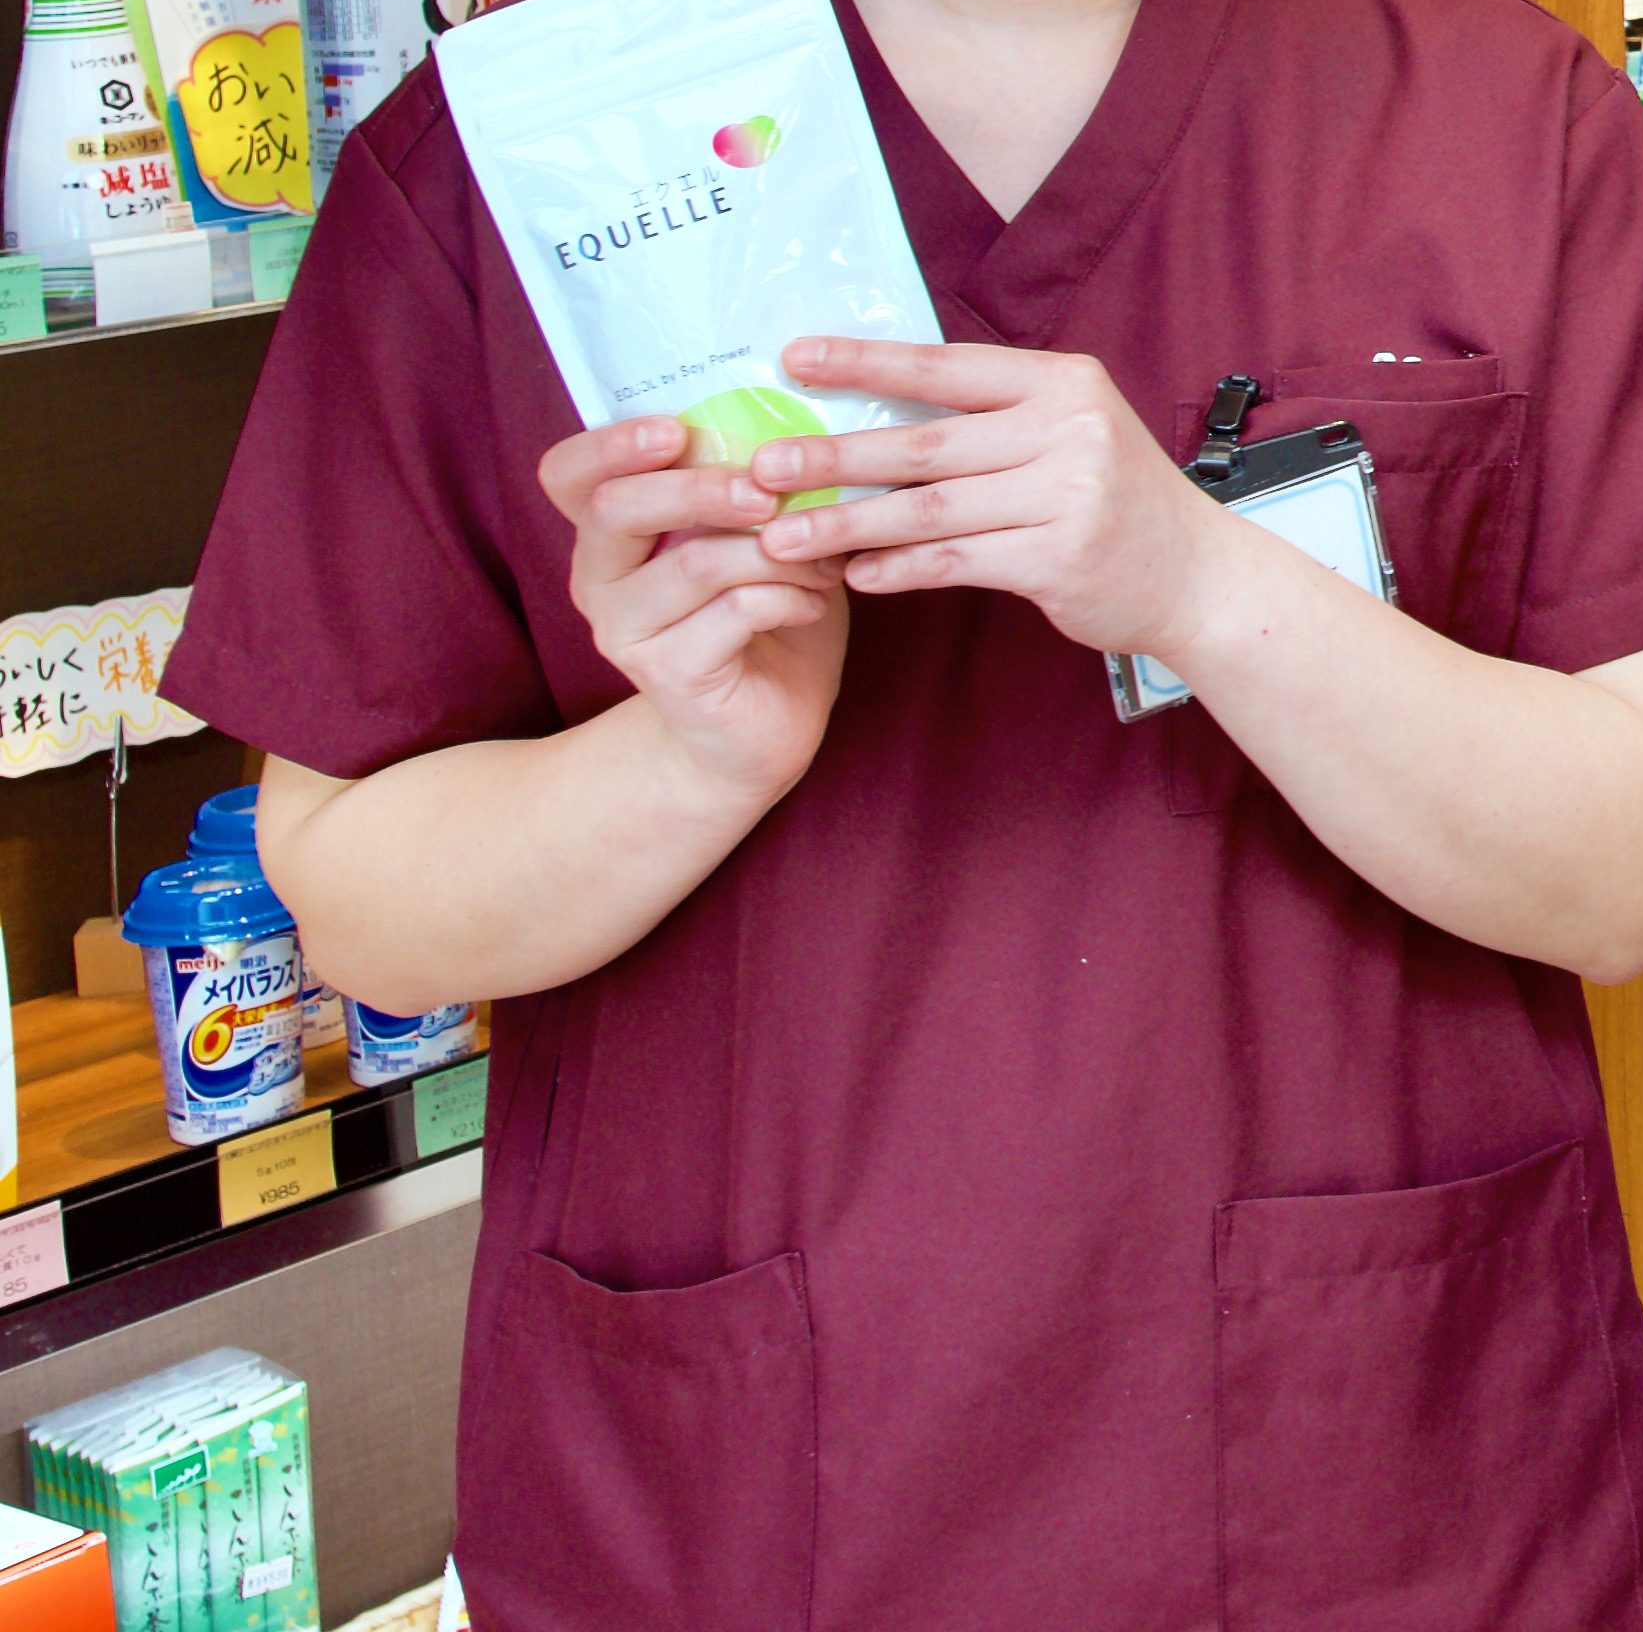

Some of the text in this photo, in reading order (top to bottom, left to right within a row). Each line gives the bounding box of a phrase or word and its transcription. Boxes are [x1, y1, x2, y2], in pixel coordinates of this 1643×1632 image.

[227, 114, 297, 175] 減
[100, 161, 171, 198] 減塩
[631, 165, 722, 209] エクエル
[554, 186, 734, 271] EQUELLE
[660, 372, 677, 388] by
[680, 358, 706, 379] Soy
[709, 342, 753, 367] Power
[0, 647, 85, 684] いしく
[202, 959, 298, 1006] メイバランス
[190, 1004, 238, 1066] 6
